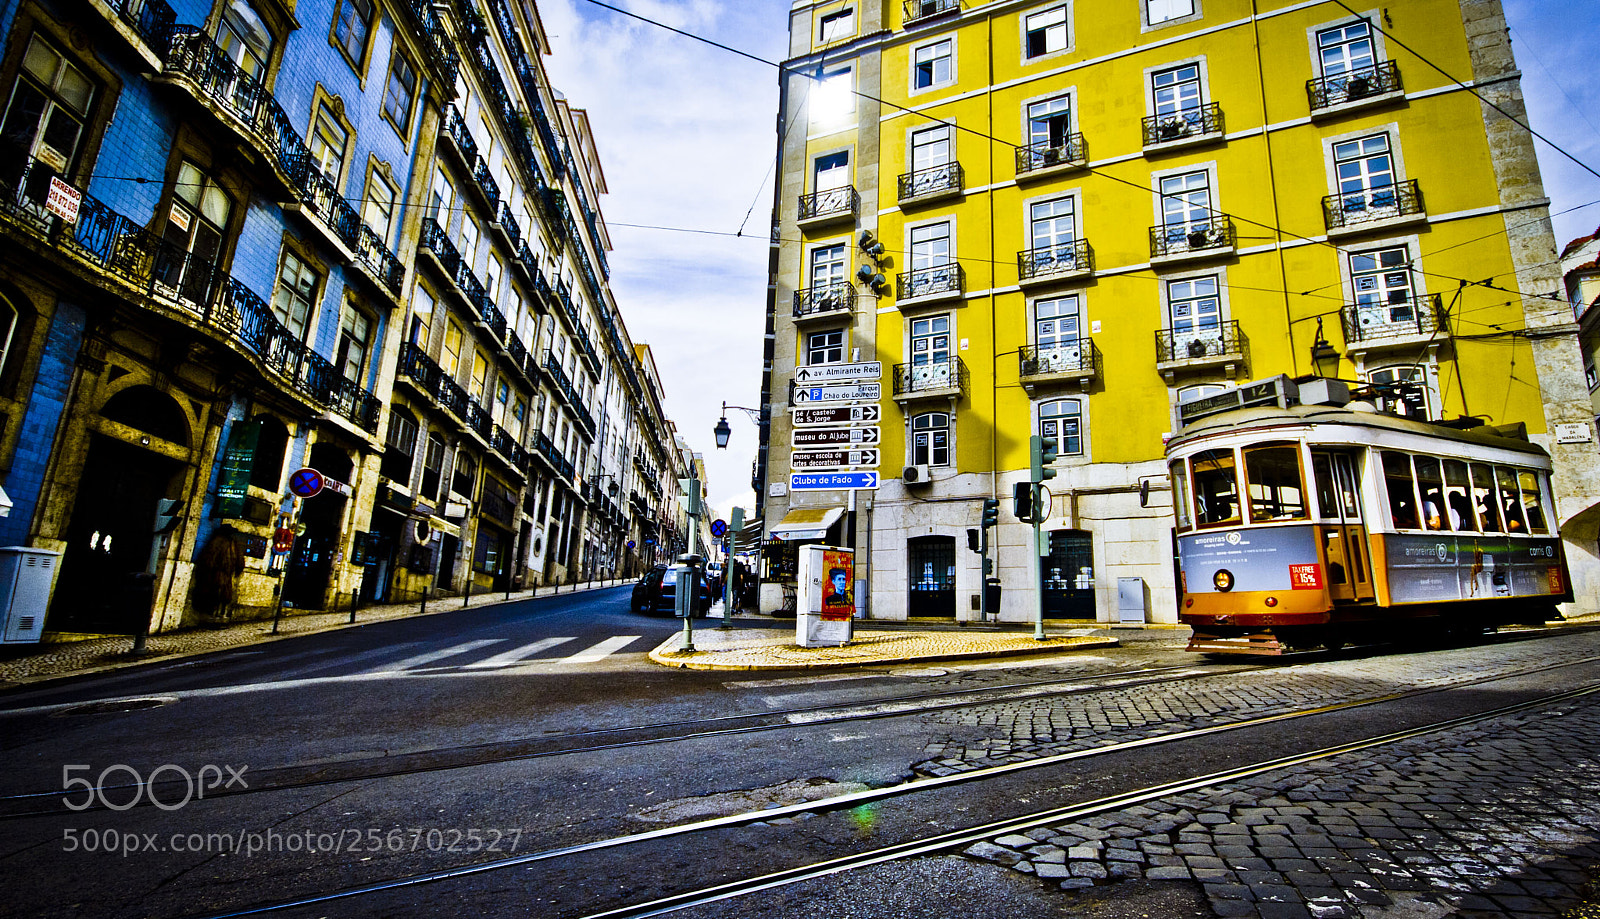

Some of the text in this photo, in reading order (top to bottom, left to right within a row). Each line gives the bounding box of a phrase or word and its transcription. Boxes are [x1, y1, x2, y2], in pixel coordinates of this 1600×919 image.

[51, 178, 81, 201] ARRENDO
[826, 367, 861, 376] Almirante
[1252, 384, 1268, 397] 12
[808, 459, 841, 467] decorativas
[792, 475, 853, 485] Clube de Fado
[1194, 535, 1225, 545] amoreiras
[1405, 547, 1436, 556] amoreiras
[1299, 573, 1316, 583] 15%
